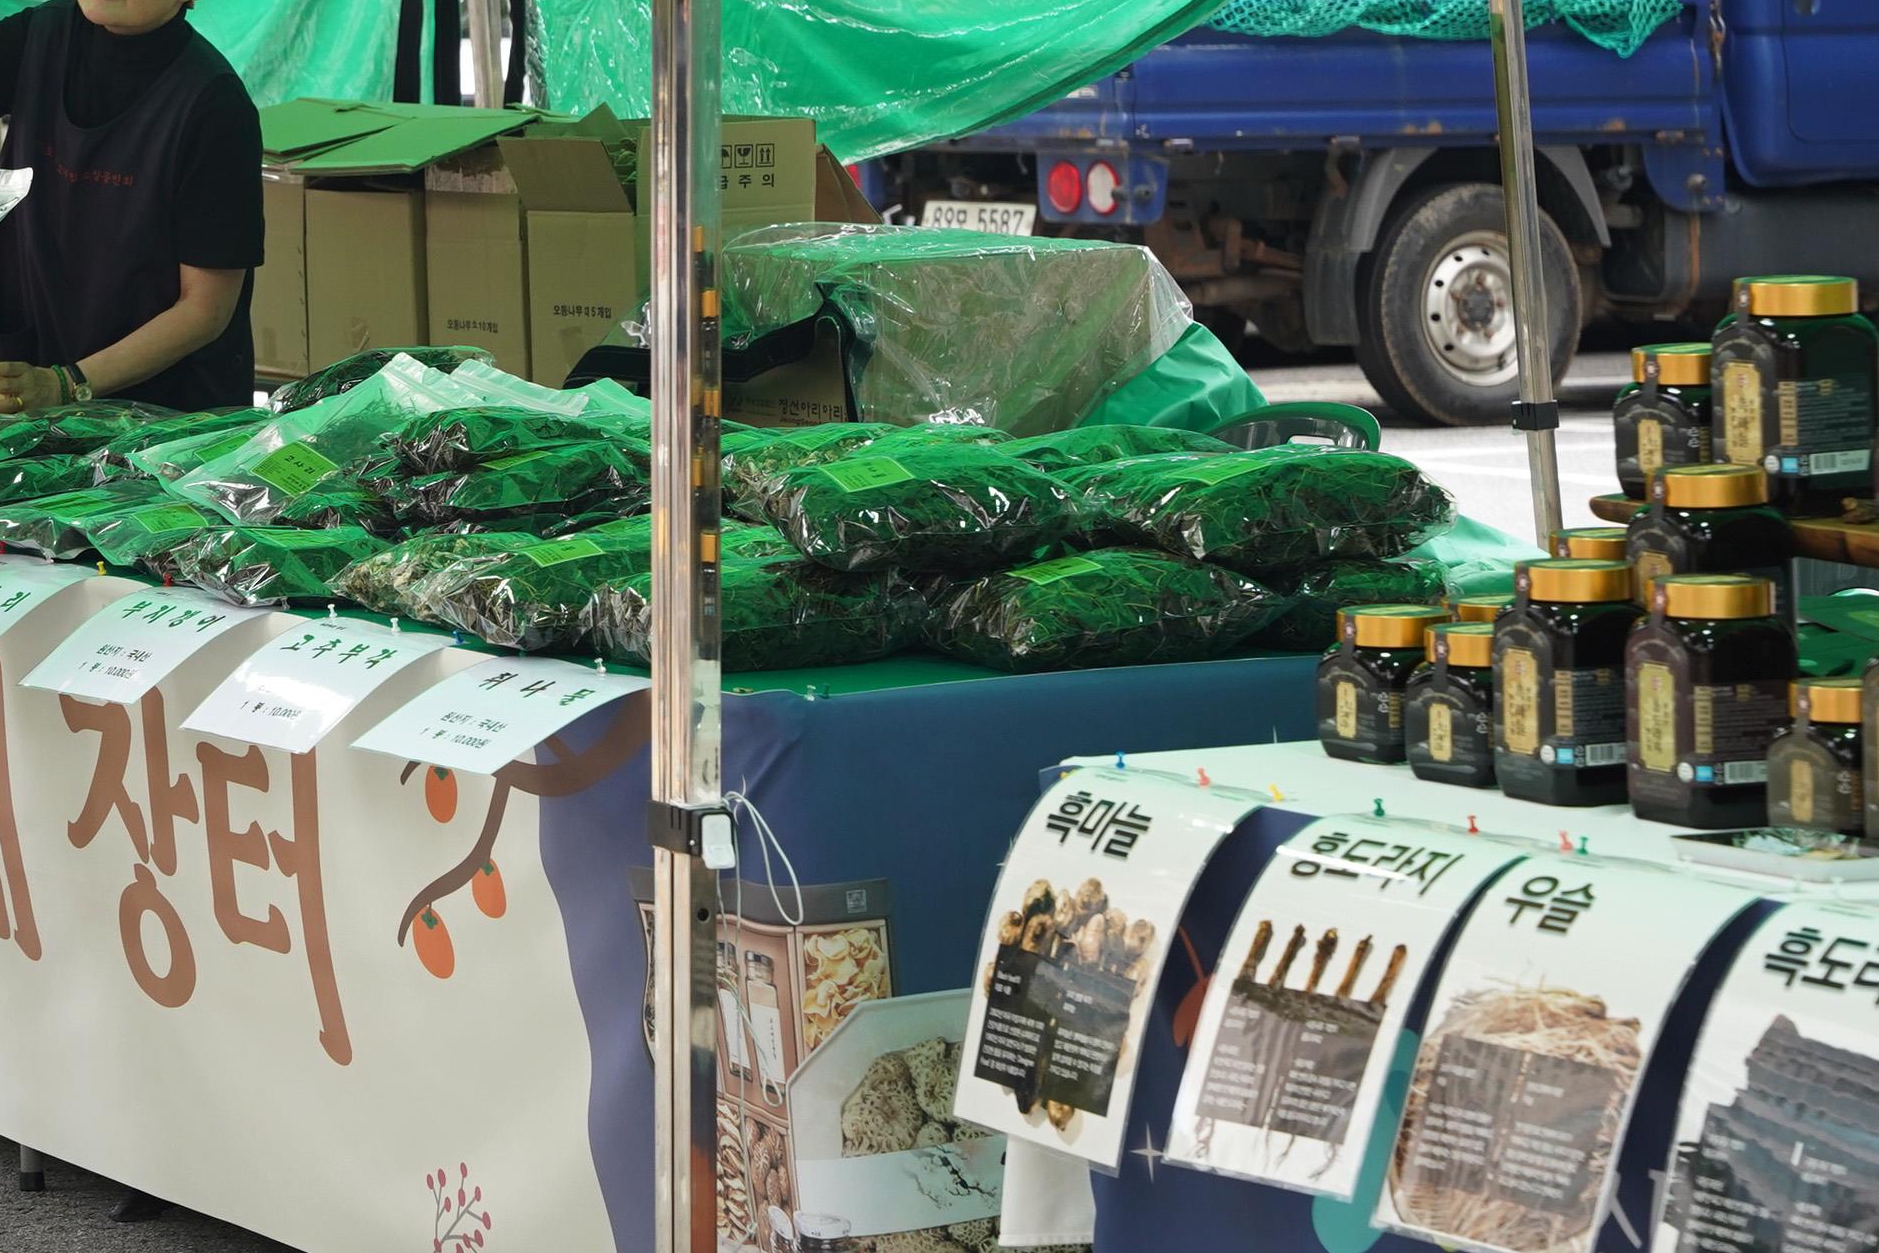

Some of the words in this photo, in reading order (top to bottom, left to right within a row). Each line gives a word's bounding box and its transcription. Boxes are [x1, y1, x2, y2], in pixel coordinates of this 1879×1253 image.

[280, 634, 399, 670] 고추부각
[1046, 790, 1153, 860] 흑마늘
[60, 691, 354, 1066] 장터
[1504, 875, 1598, 935] 우슬
